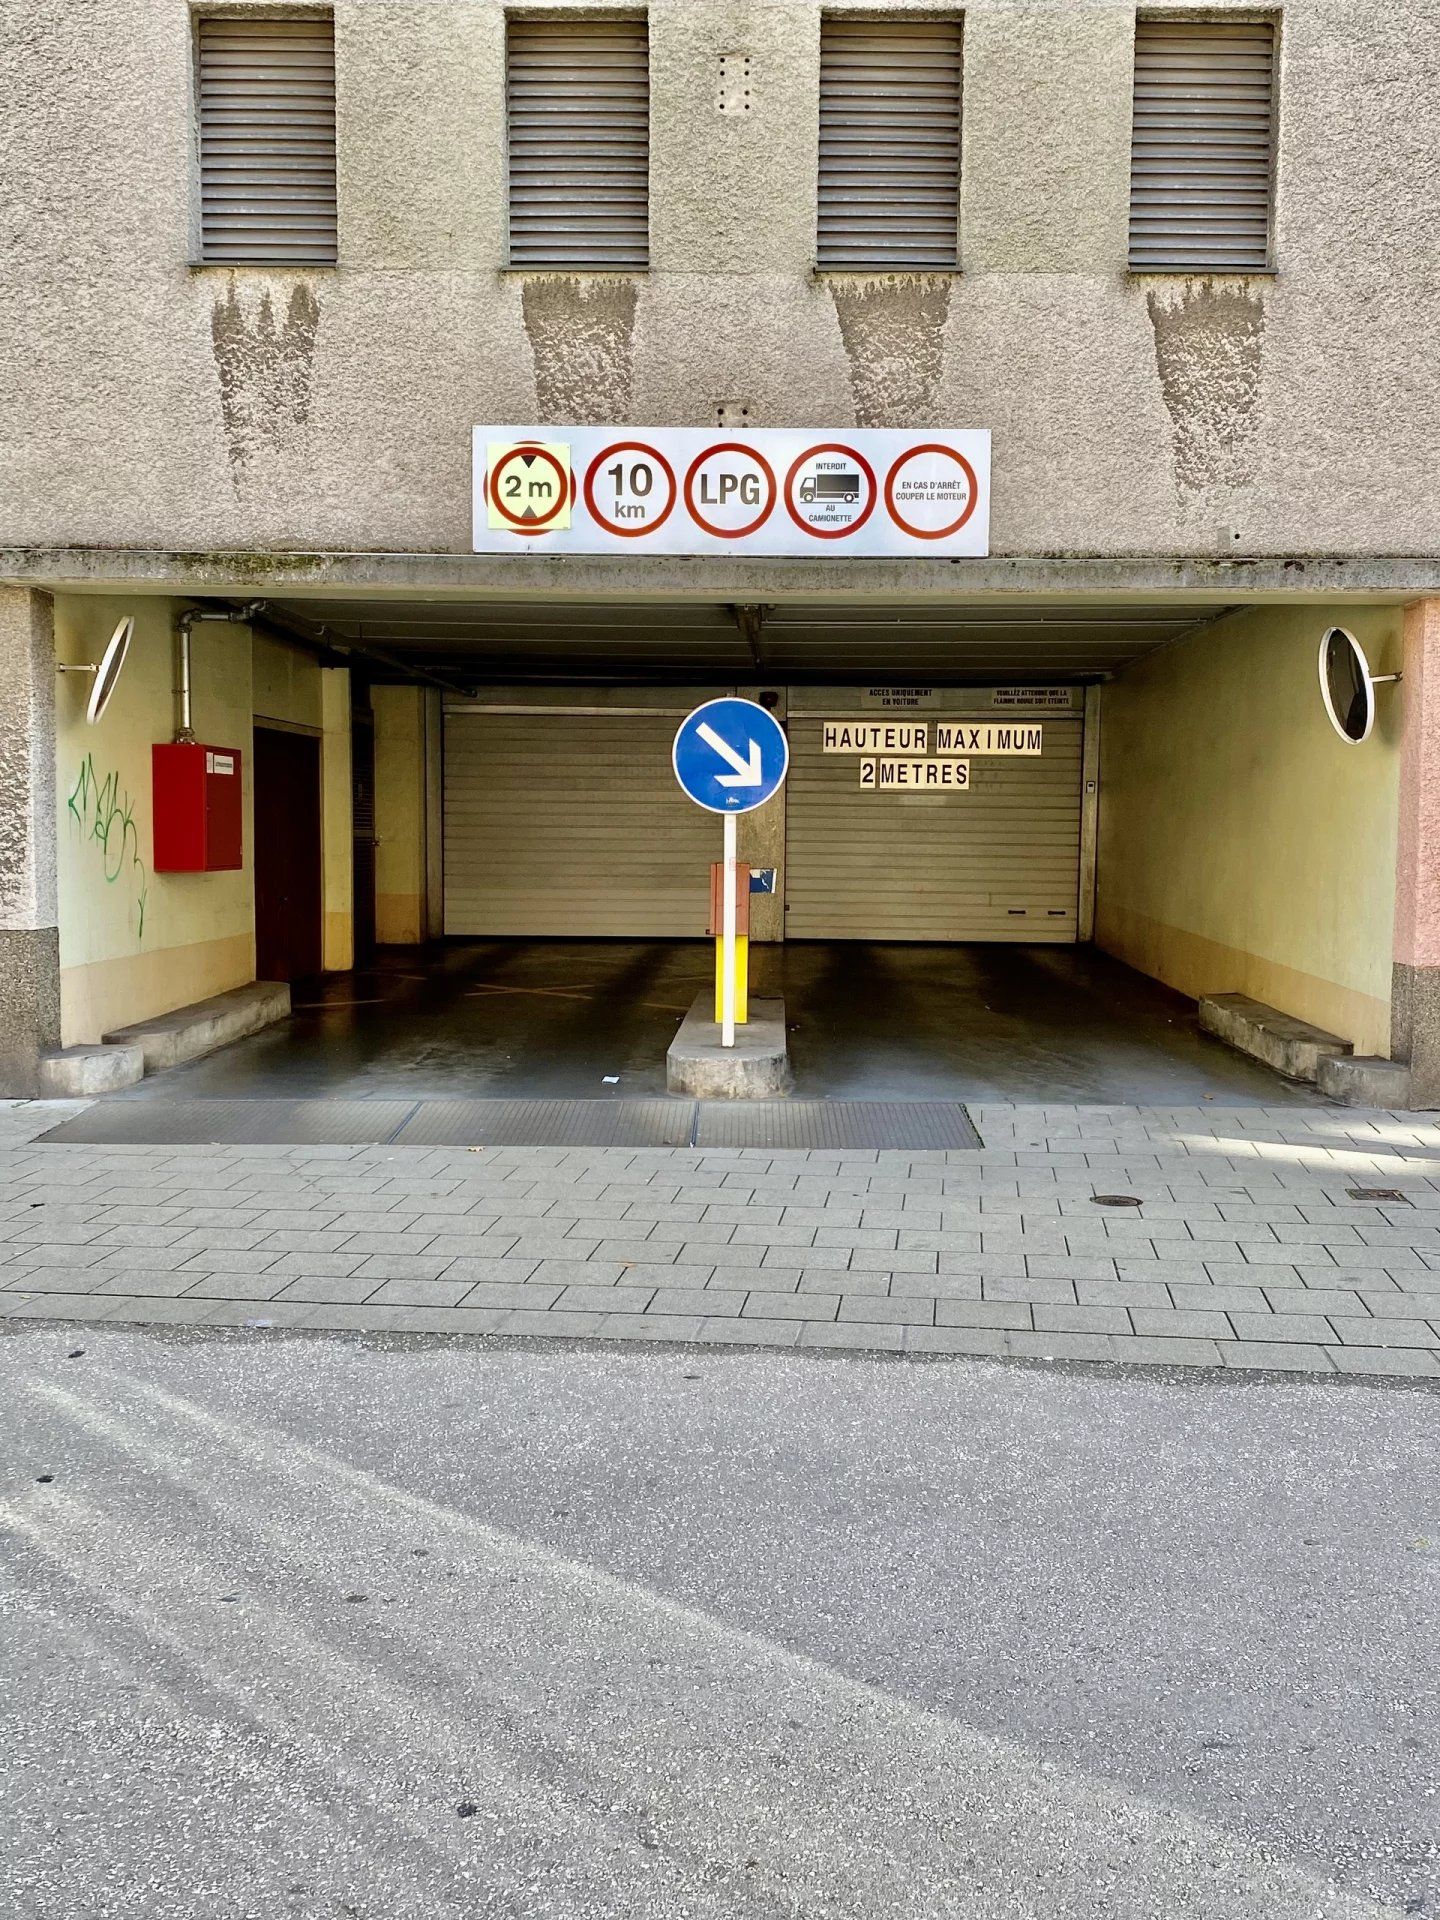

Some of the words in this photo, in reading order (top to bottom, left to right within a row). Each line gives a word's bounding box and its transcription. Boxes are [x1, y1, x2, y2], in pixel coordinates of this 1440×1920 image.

[505, 476, 522, 498] 2
[527, 480, 552, 498] m
[607, 464, 653, 496] 10
[700, 474, 760, 505] LPG
[902, 481, 911, 489] EN
[913, 481, 928, 489] CAS
[930, 480, 961, 489] D'ARRÊT
[896, 492, 924, 500] COUPER
[926, 492, 935, 500] LE
[937, 492, 967, 500] MOTEUR
[615, 501, 646, 518] km
[826, 728, 926, 748] HAUTEUR
[938, 729, 1041, 750] MAXIMUM
[862, 763, 874, 783] 2
[881, 764, 967, 784] METRES
